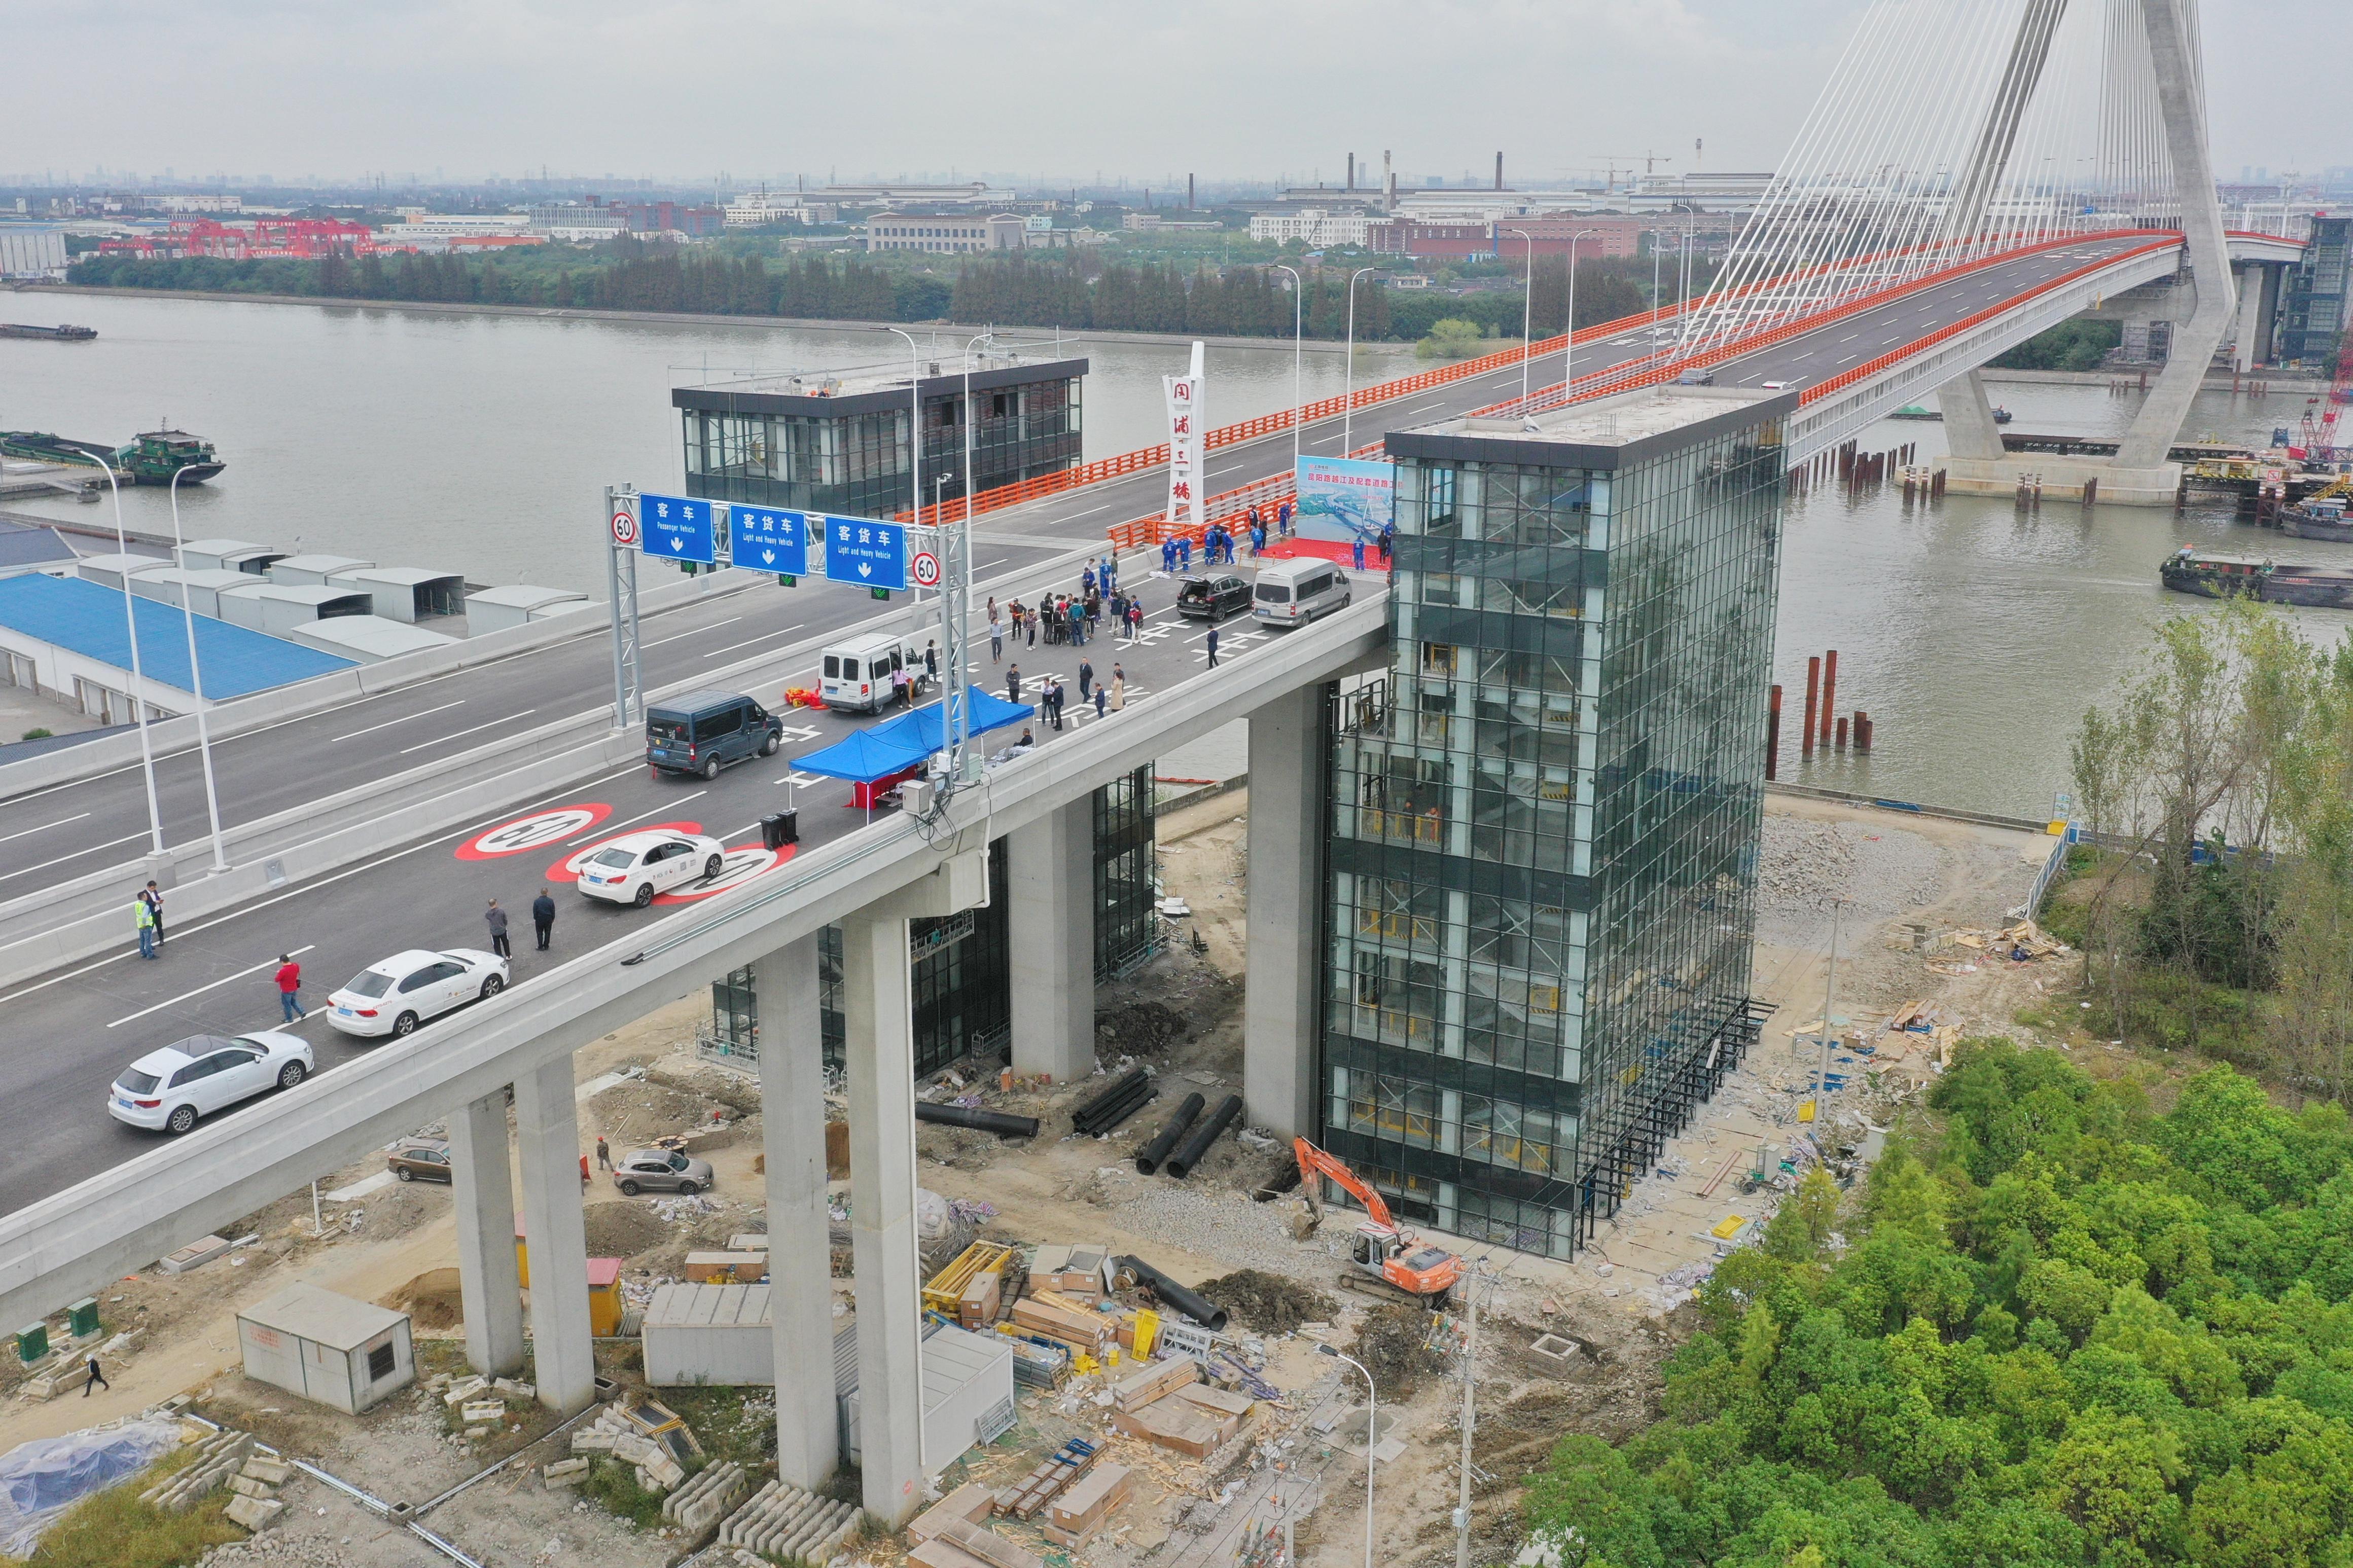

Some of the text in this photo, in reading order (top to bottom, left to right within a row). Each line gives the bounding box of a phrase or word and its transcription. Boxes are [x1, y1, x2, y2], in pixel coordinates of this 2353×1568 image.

[657, 502, 694, 521] 客车
[617, 519, 630, 536] 60
[657, 522, 695, 533] Passenger Vehicle
[743, 514, 793, 533] 客货车
[743, 532, 754, 543] Light
[764, 536, 777, 546] Heavy
[778, 537, 793, 546] Vehicle
[838, 525, 890, 546] 客货车
[838, 545, 849, 556] Light
[861, 548, 873, 559] Heavy
[875, 550, 890, 560] Vehicle
[918, 560, 934, 579] 60
[1316, 1160, 1333, 1174] HITACHI
[1436, 1275, 1453, 1286] HITACHI
